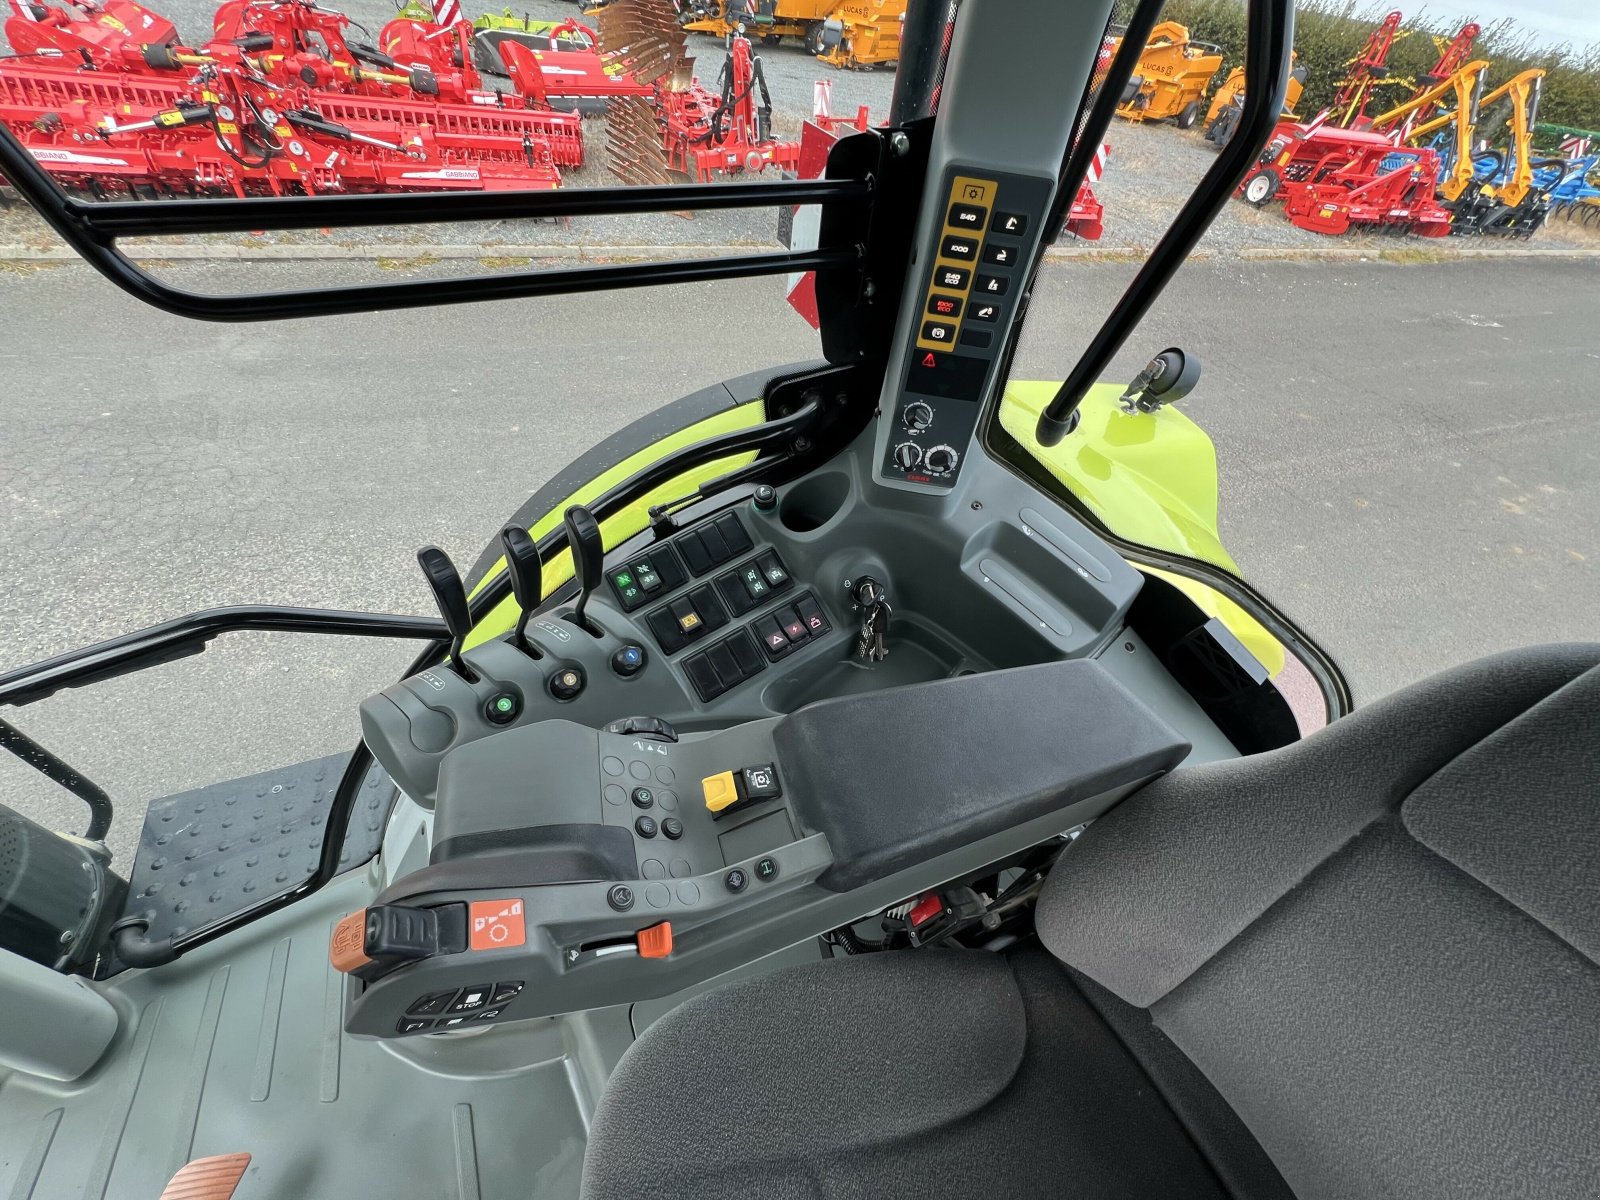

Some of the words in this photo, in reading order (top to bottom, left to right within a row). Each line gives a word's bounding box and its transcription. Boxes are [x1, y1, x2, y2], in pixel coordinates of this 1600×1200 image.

[843, 5, 862, 15] LUCAS
[1142, 62, 1165, 73] LUCAS
[33, 151, 68, 160] BBIANO
[960, 213, 977, 221] 540
[951, 245, 969, 253] 1000
[937, 300, 954, 308] 1000
[456, 1001, 483, 1009] STOP
[479, 1010, 499, 1018] F2
[406, 1022, 424, 1032] F1
